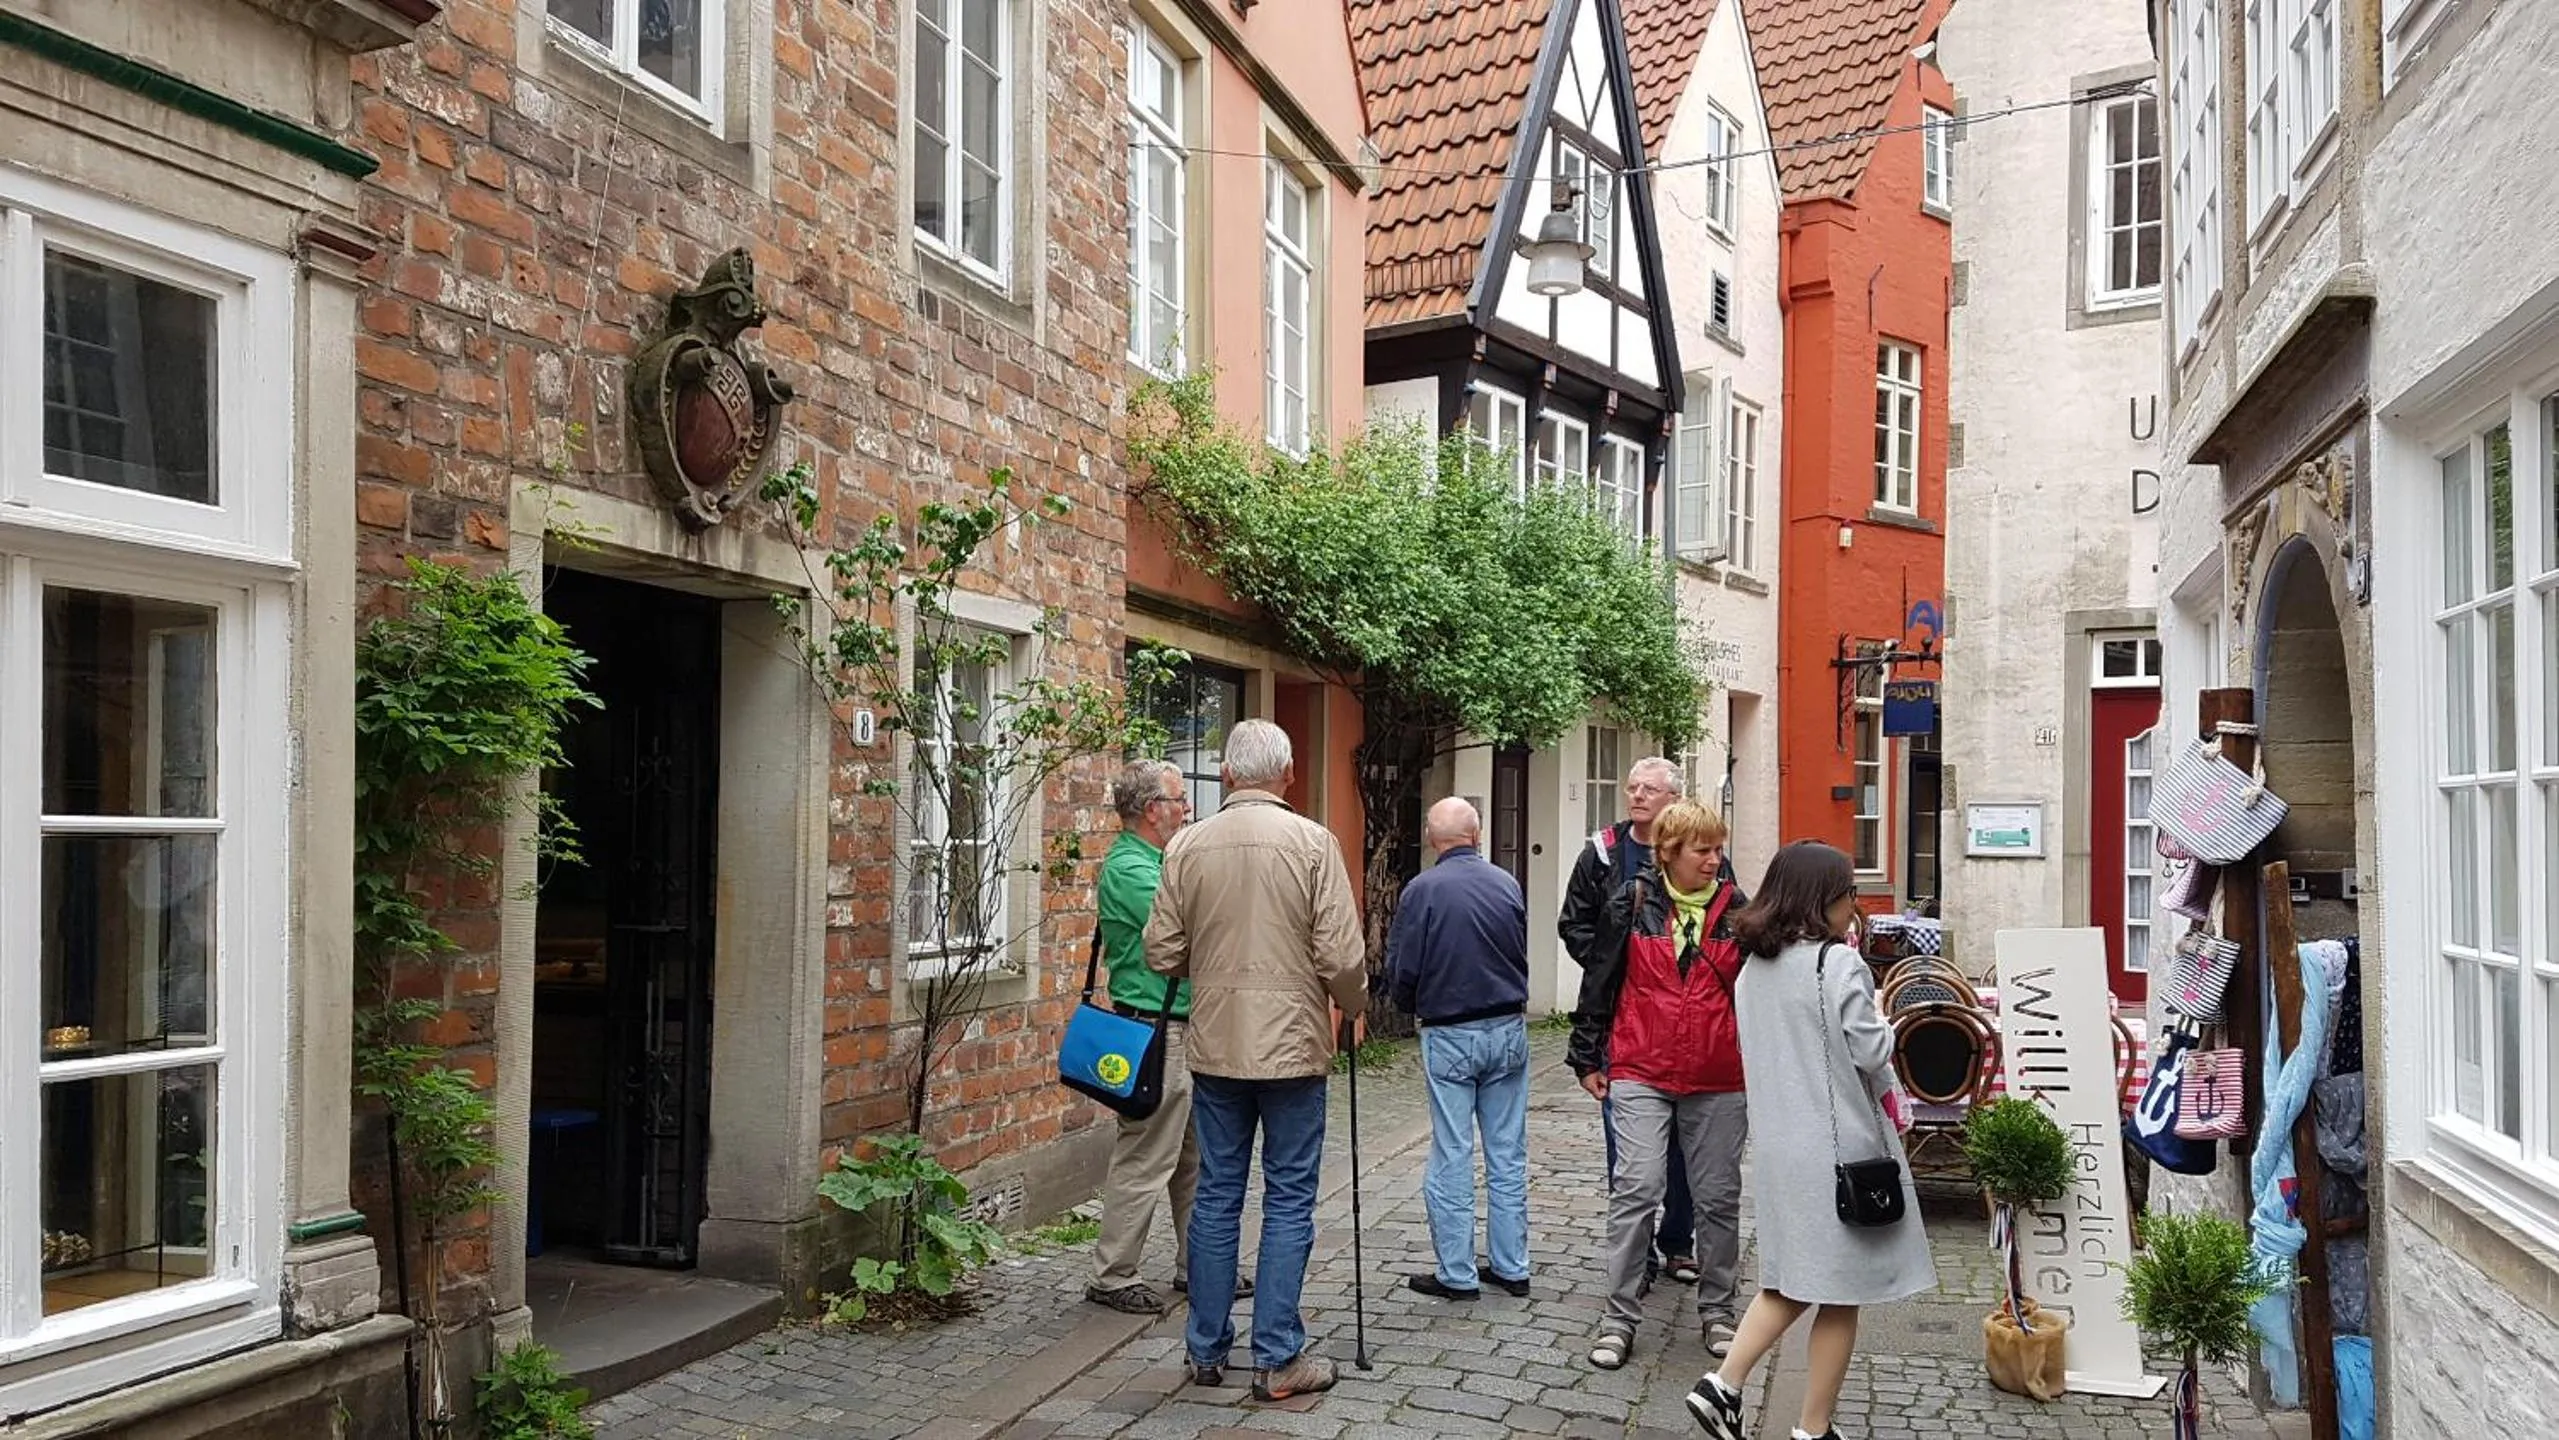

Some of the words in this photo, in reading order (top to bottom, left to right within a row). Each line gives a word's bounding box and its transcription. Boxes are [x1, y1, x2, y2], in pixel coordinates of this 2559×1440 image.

[861, 713, 869, 740] 8
[2010, 967, 2076, 1330] Willkmen
[2071, 1123, 2115, 1278] Herzlich
